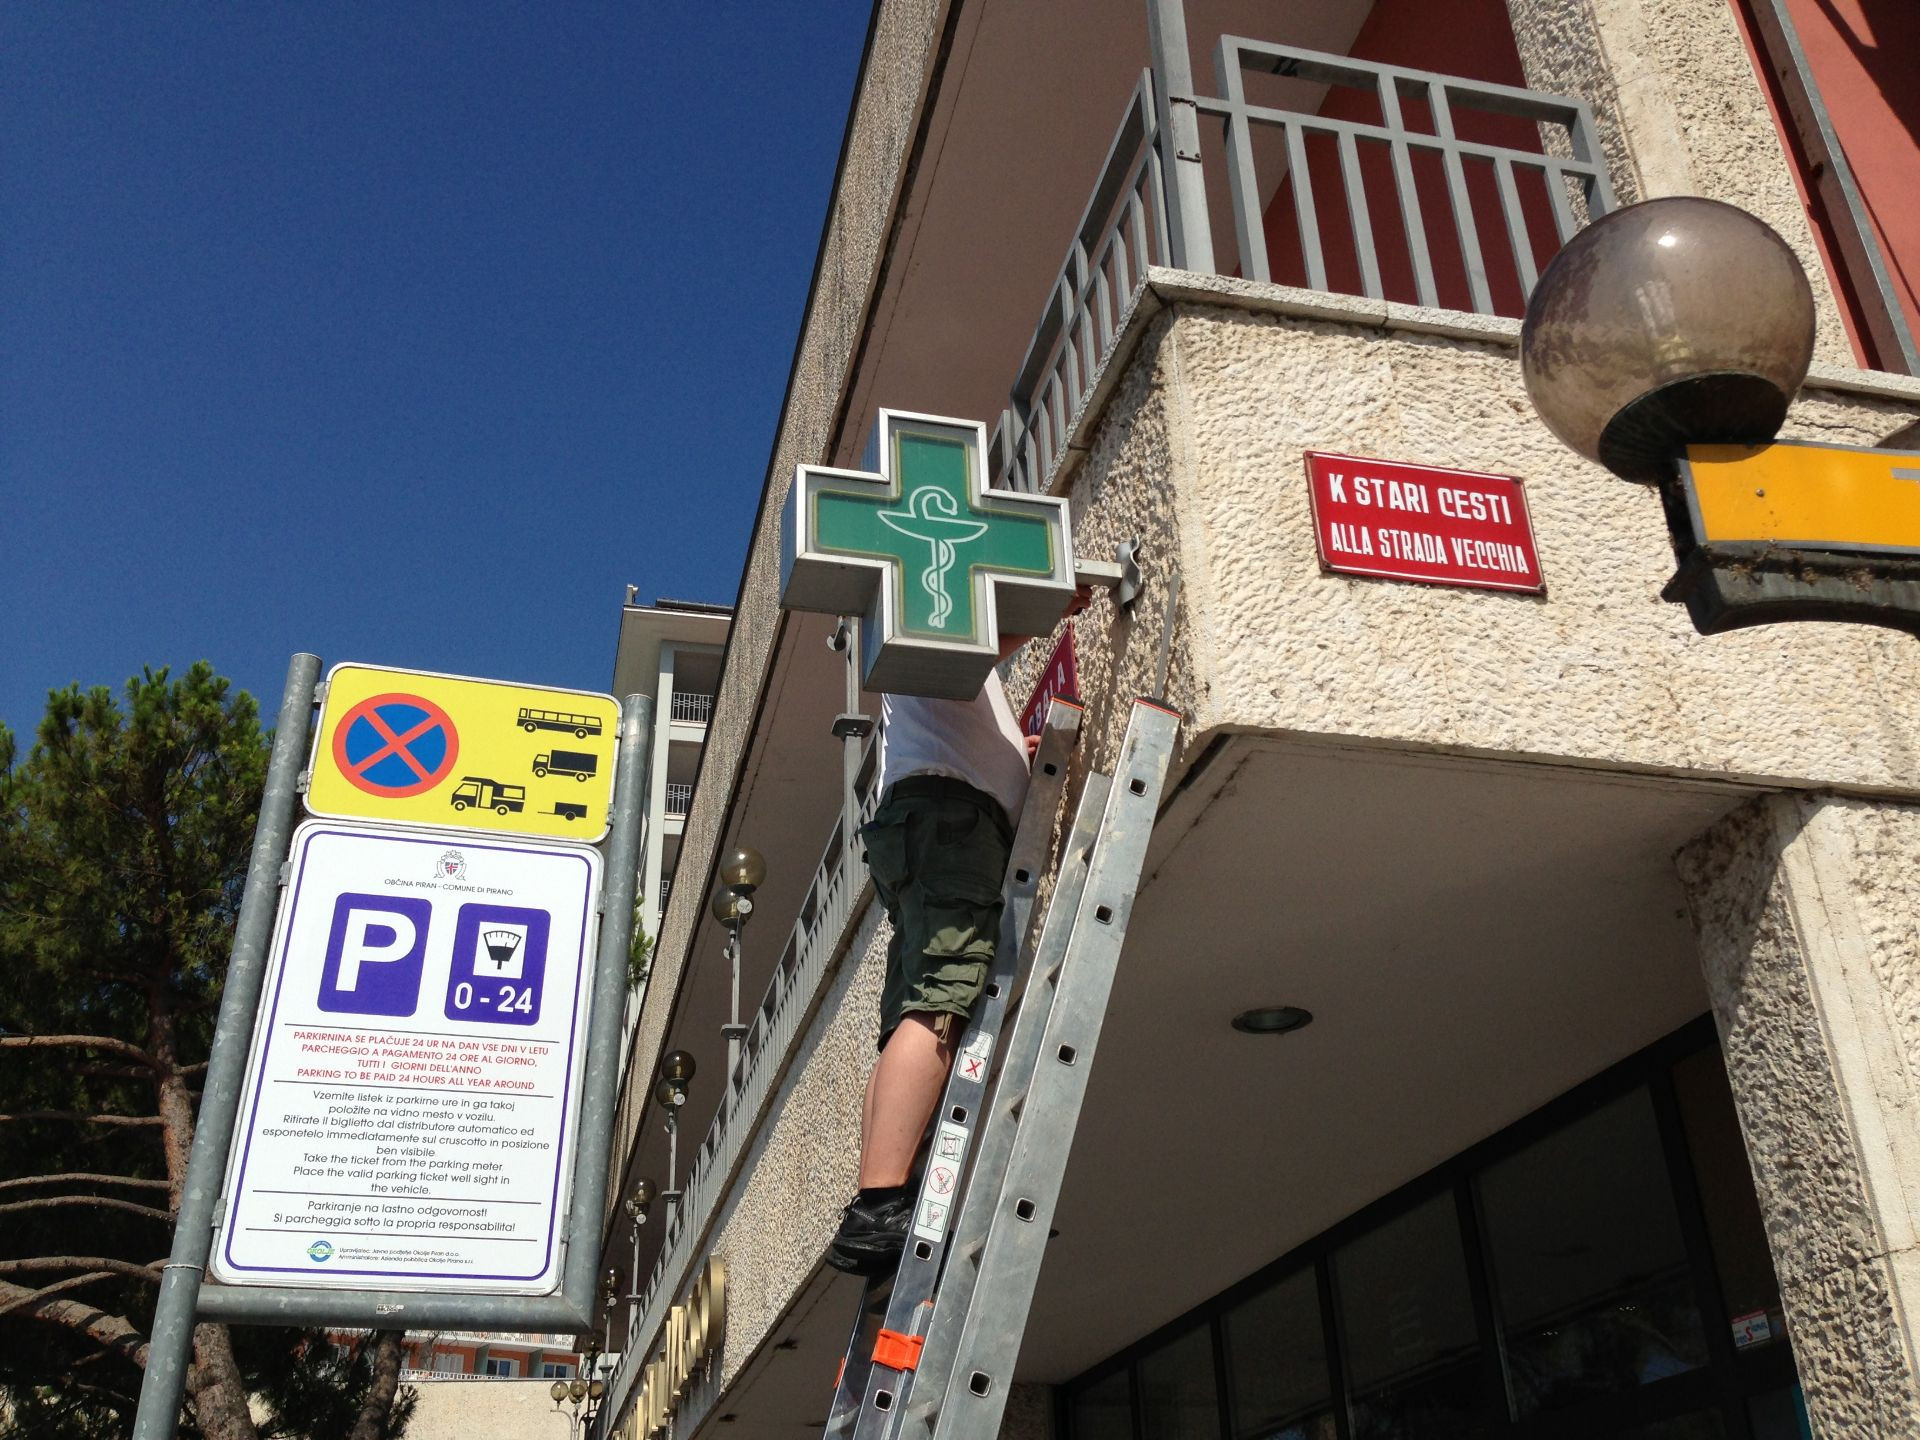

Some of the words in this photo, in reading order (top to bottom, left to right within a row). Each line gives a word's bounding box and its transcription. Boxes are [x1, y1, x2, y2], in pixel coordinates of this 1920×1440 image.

[1329, 473, 1347, 504] K
[1353, 476, 1430, 514] STARI
[1437, 487, 1513, 525] CESTI
[1330, 522, 1374, 556] ALLA
[1378, 528, 1448, 565] STRADA
[1450, 537, 1530, 575] VECCHIA
[384, 877, 414, 888] OBČINA
[415, 881, 437, 890] PIRAN
[442, 884, 476, 893] COMUNE
[486, 888, 514, 896] PIRANO
[335, 909, 417, 992] P
[497, 985, 533, 1014] 24
[293, 1031, 352, 1042] PARKIRNINA
[354, 1034, 366, 1043] SE
[368, 1034, 410, 1046] PLAČUJE
[411, 1038, 424, 1046] 24
[426, 1039, 439, 1048] UR
[441, 1040, 455, 1049] NA
[458, 1041, 479, 1050] DAN
[481, 1042, 499, 1051] VSE
[500, 1044, 517, 1053] DNI
[519, 1045, 527, 1053] V
[528, 1045, 548, 1055] LETU
[301, 1043, 369, 1055] PARCHEGGIO
[371, 1048, 379, 1056] A
[381, 1048, 443, 1060] PAGAMENTO
[444, 1052, 457, 1061] 24
[458, 1053, 479, 1062] ORE
[480, 1054, 492, 1063] AL
[494, 1055, 537, 1067] GIORNO,
[357, 1058, 380, 1068] TUTTI
[390, 1061, 427, 1071] GIORNI
[428, 1063, 482, 1074] DELL'ANNO
[296, 1067, 341, 1078] PARKING
[343, 1070, 357, 1079] TO
[359, 1071, 371, 1080] BE
[373, 1072, 396, 1081] PAID
[397, 1073, 410, 1082] 24
[412, 1074, 446, 1084] HOURS
[447, 1076, 464, 1085] ALL
[467, 1077, 491, 1087] YEAR
[492, 1079, 534, 1090] AROUND
[312, 1089, 354, 1101] Vzemite
[356, 1092, 383, 1102] listek
[385, 1094, 394, 1103] iz
[395, 1095, 440, 1105] parkirne
[460, 1098, 470, 1107] in
[472, 1100, 487, 1110] ga
[489, 1100, 515, 1112] takoj
[327, 1104, 371, 1115] položite
[390, 1107, 419, 1117] vidno
[421, 1110, 454, 1119] mesto
[464, 1112, 495, 1122] vozilu.
[282, 1114, 319, 1125] Ritirate
[322, 1115, 328, 1125] il
[330, 1116, 374, 1128] biglietto
[376, 1119, 395, 1128] dal
[396, 1120, 455, 1131] distributore
[456, 1123, 518, 1135] automatico
[519, 1127, 534, 1136] ed
[262, 1128, 324, 1138] esponetelo
[326, 1129, 419, 1143] immediatamente
[421, 1134, 436, 1144] sul
[438, 1136, 487, 1146] cruscotto
[489, 1138, 499, 1147] in
[500, 1139, 549, 1150] posizione
[375, 1145, 397, 1155] ben
[303, 1152, 328, 1162] Take
[330, 1153, 348, 1163] the
[350, 1155, 379, 1165] ticket
[381, 1155, 406, 1166] from
[408, 1157, 426, 1167] the
[428, 1159, 469, 1171] parking
[292, 1165, 324, 1176] Place
[326, 1167, 344, 1177] the
[346, 1168, 373, 1178] valid
[375, 1170, 417, 1182] parking
[419, 1171, 448, 1182] ticket
[450, 1173, 471, 1183] well
[473, 1174, 498, 1185] sight
[500, 1175, 510, 1184] in
[370, 1182, 388, 1192] the
[390, 1184, 431, 1194] vehicle.
[307, 1200, 361, 1214] Parkiranje
[363, 1204, 379, 1212] na
[381, 1203, 414, 1214] lastno
[272, 1212, 282, 1222] Si
[284, 1214, 351, 1227] parcheggia
[353, 1216, 380, 1226] sotto
[382, 1217, 394, 1227] la
[395, 1219, 436, 1229] propria
